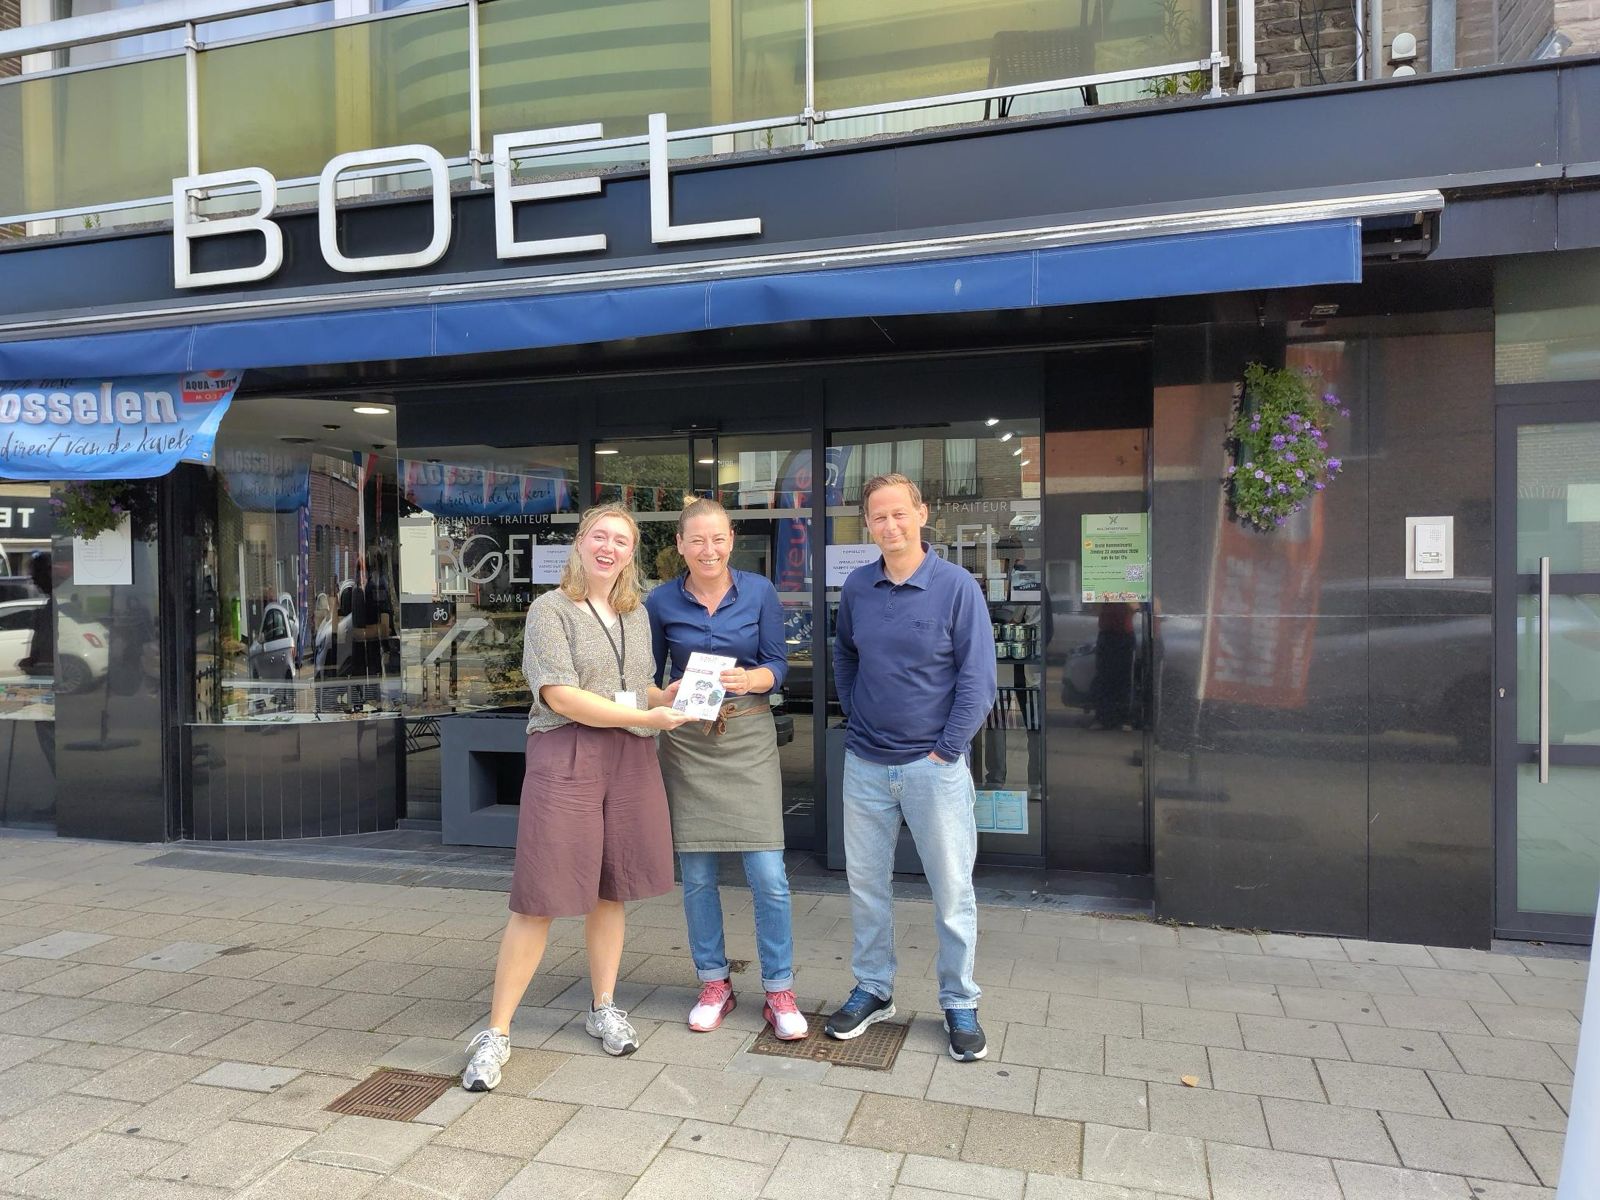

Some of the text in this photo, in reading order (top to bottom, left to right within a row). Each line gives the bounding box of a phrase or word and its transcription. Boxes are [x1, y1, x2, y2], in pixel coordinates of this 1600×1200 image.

[172, 113, 763, 290] BOEL
[0, 382, 177, 425] osselen
[434, 513, 549, 526] VISHANDEL TRAITEUR
[945, 501, 1008, 513] TRAITEUR
[431, 533, 538, 584] BOE
[489, 593, 512, 603] SAM
[515, 593, 523, 602] &
